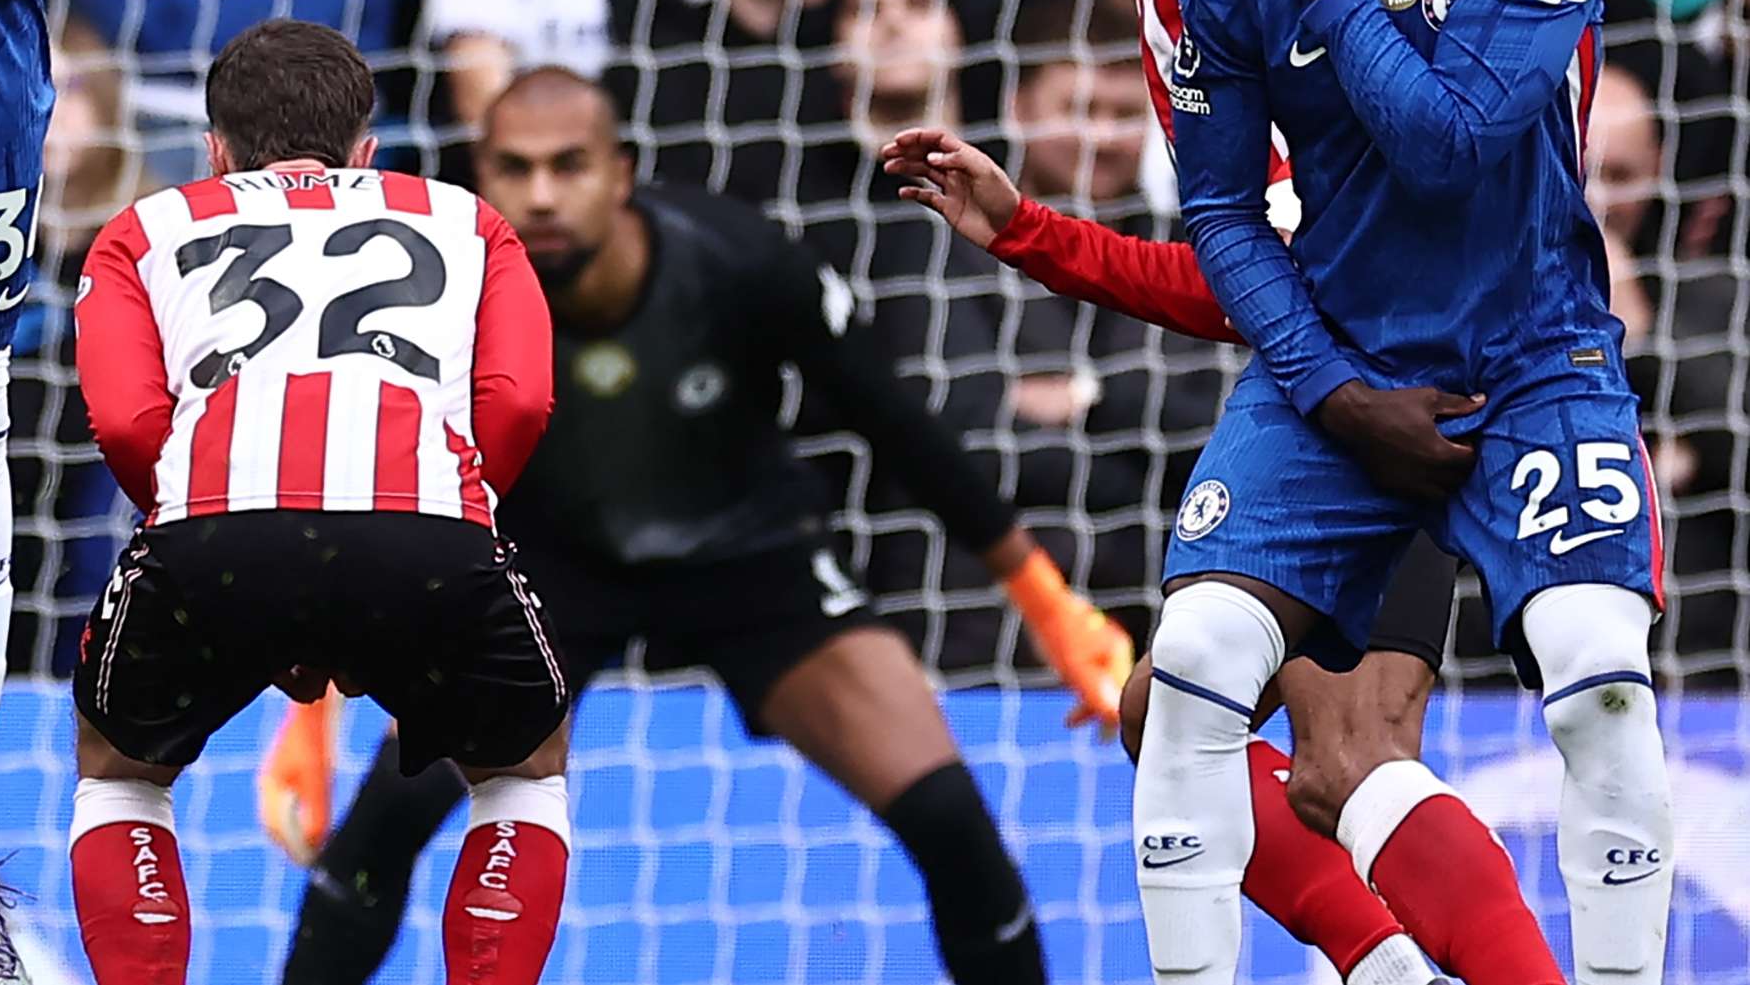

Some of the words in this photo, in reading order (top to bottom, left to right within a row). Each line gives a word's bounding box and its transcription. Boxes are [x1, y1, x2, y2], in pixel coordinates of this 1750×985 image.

[174, 218, 447, 385] 32
[1510, 441, 1642, 541] 25
[130, 827, 169, 903] SAFC
[478, 820, 517, 890] SAFC
[1143, 835, 1202, 850] CFC
[1606, 848, 1661, 865] CFC
